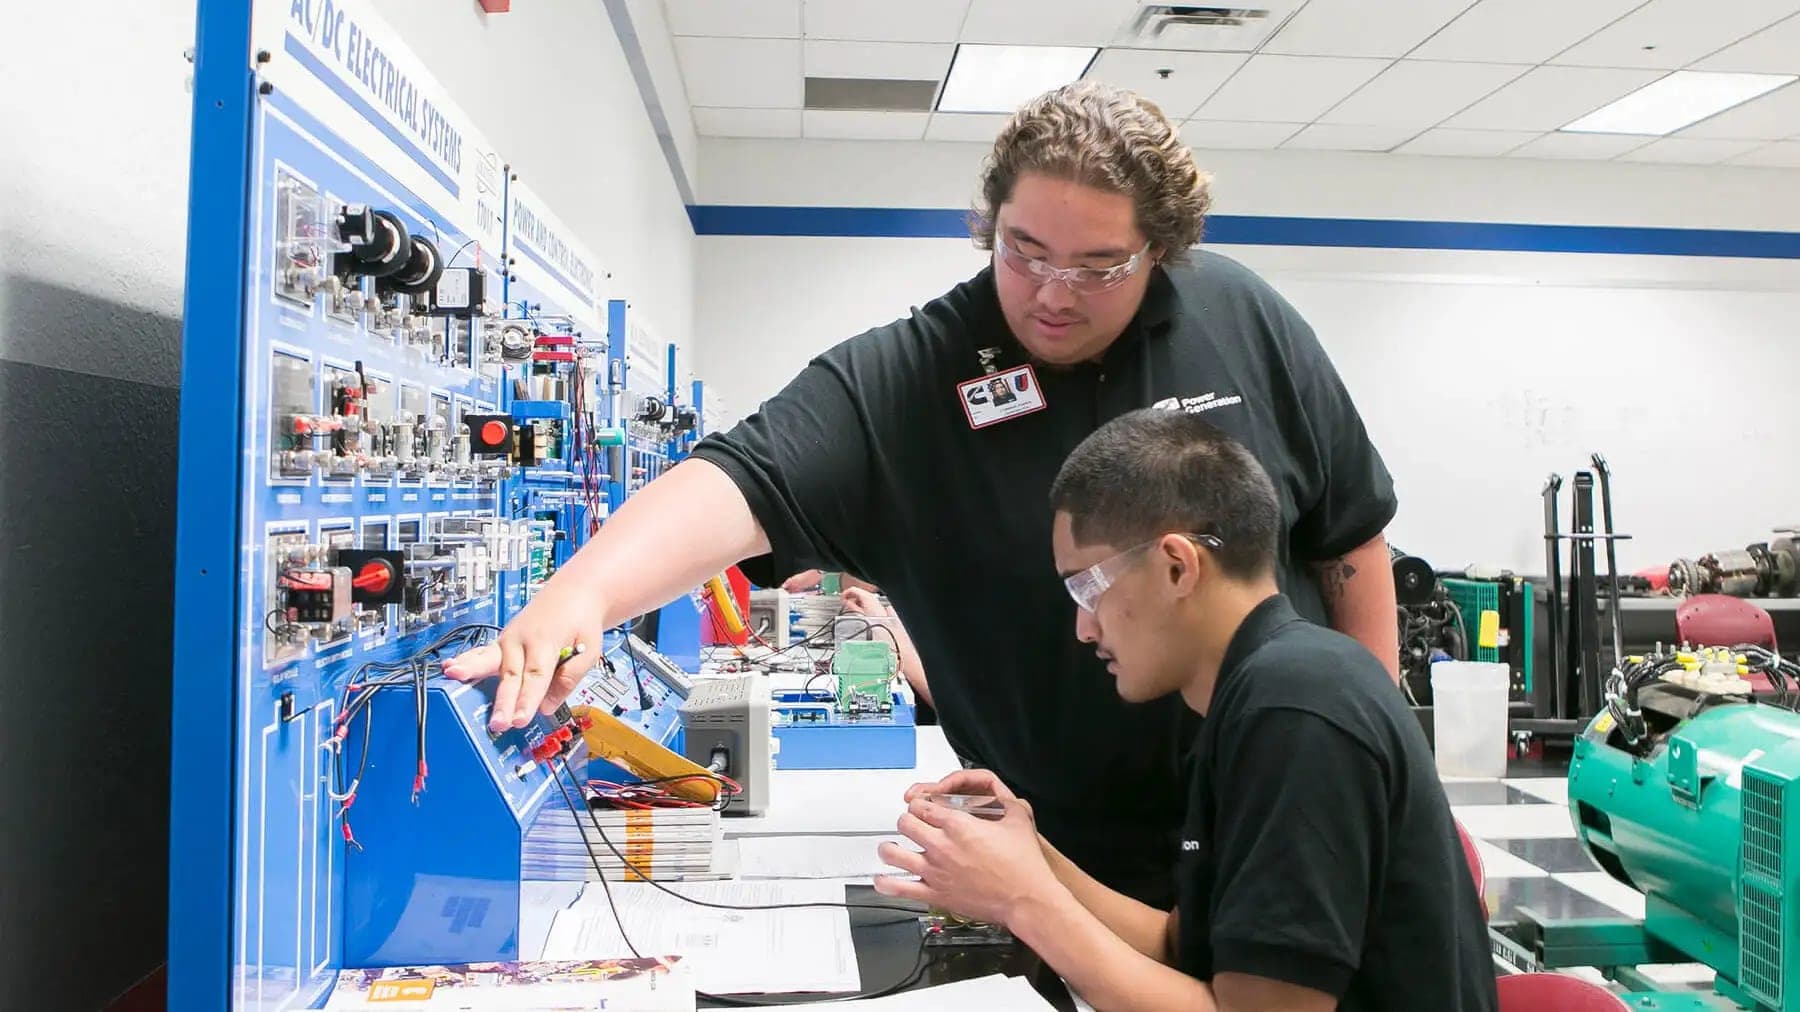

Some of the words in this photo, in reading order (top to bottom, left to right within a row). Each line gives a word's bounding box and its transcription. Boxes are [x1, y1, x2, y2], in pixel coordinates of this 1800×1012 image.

[346, 20, 418, 132] ELECTRICAL
[420, 98, 462, 174] SYSTEMS
[513, 197, 535, 242] POWER
[535, 217, 548, 253] AND
[547, 230, 570, 273] CONTROL
[1181, 392, 1215, 407] Power
[1185, 395, 1242, 414] Generation
